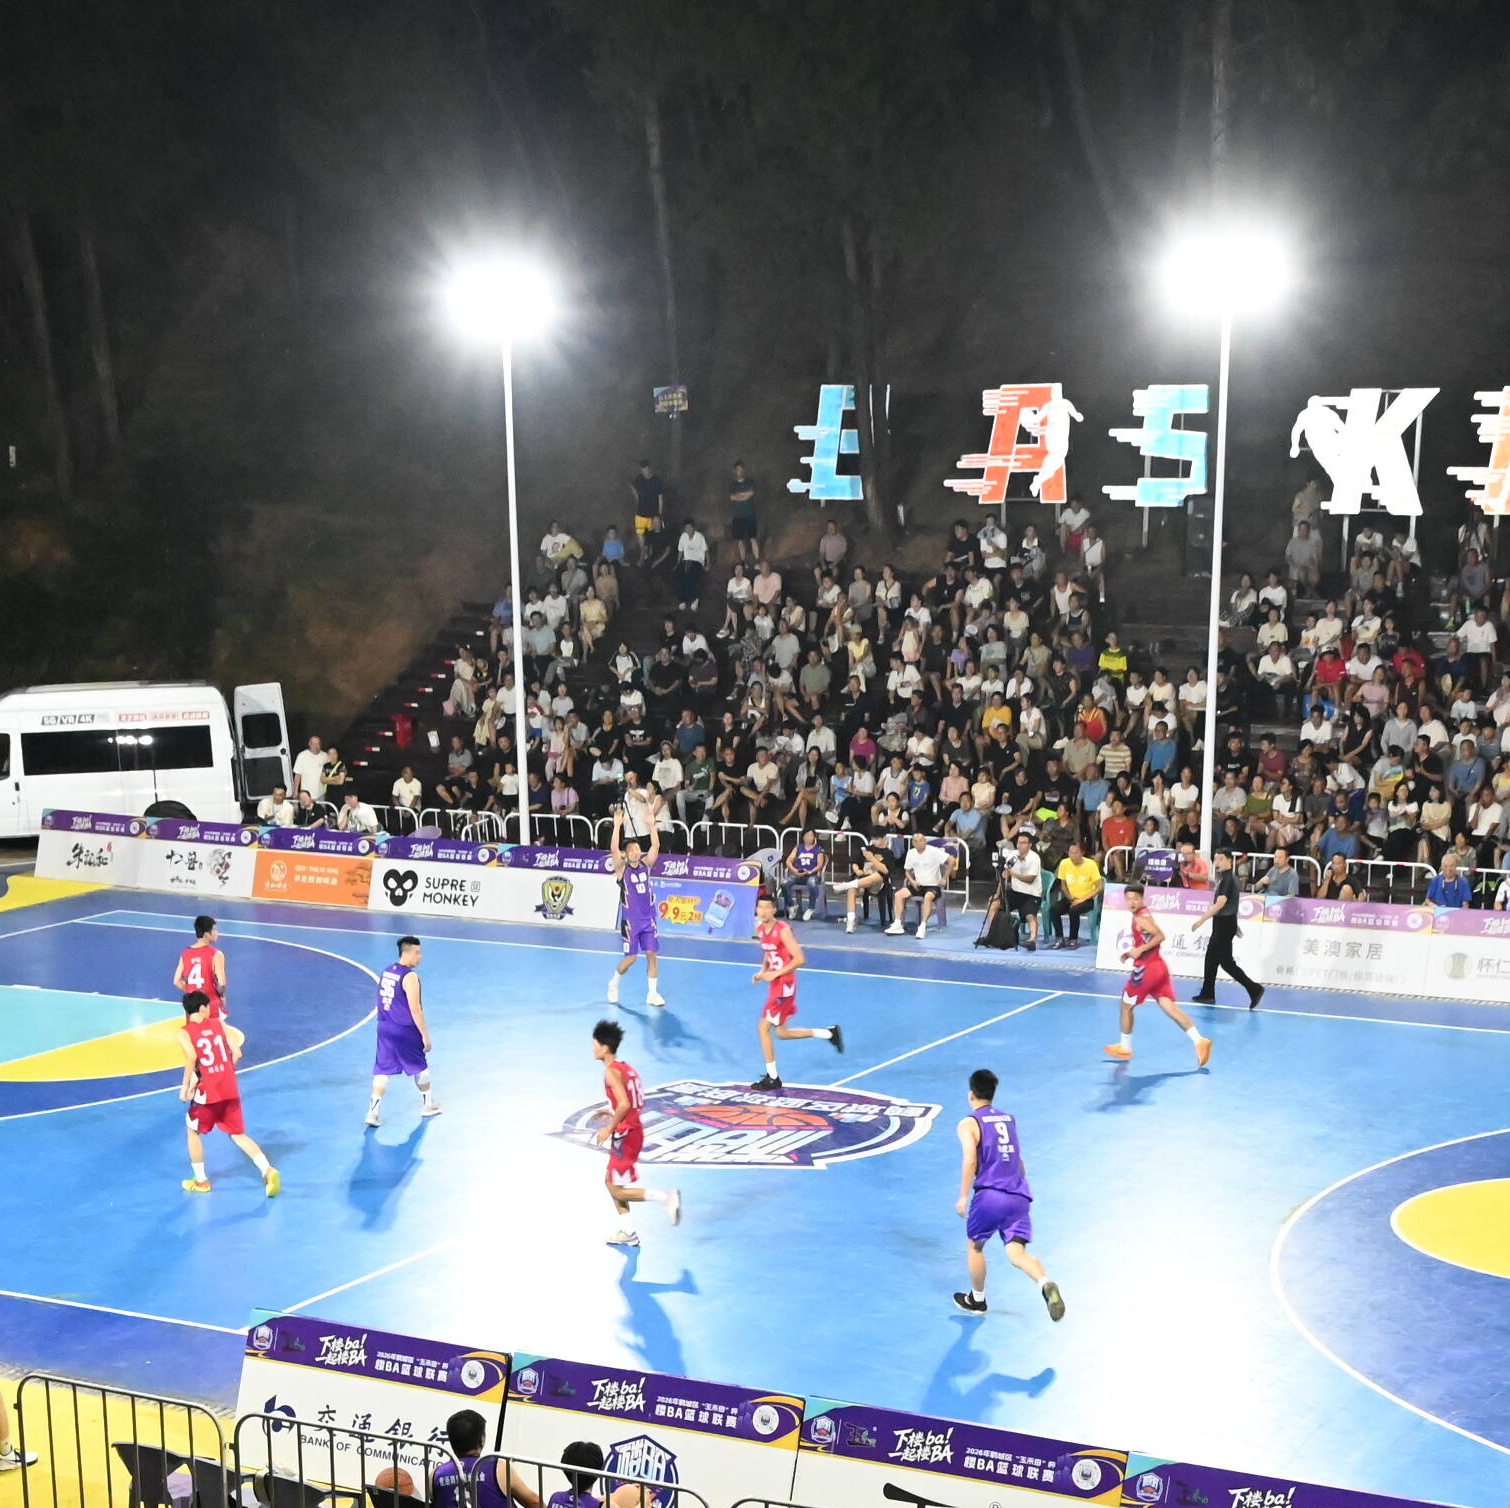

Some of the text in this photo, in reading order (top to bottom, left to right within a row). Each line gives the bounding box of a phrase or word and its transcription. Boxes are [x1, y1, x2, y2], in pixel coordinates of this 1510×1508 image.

[425, 877, 466, 892] SUPRE
[422, 892, 479, 908] MONKEY
[1303, 938, 1385, 960] 美澳家居
[187, 964, 204, 989] 4
[196, 1035, 229, 1068] 31
[997, 1122, 1011, 1146] 9
[319, 1333, 368, 1354] 下楼ba!
[315, 1349, 368, 1367] 一起楼BA
[592, 1377, 646, 1398] 下楼ba!
[587, 1396, 645, 1412] 一起楼BA
[655, 1405, 738, 1428] 楼BA篮球联赛
[300, 1434, 332, 1449] BANK
[337, 1441, 351, 1452] OF
[893, 1427, 954, 1450] 下楼ba!
[888, 1445, 954, 1464] 一起楼BA
[963, 1457, 1055, 1483] 楼BA篮球联赛
